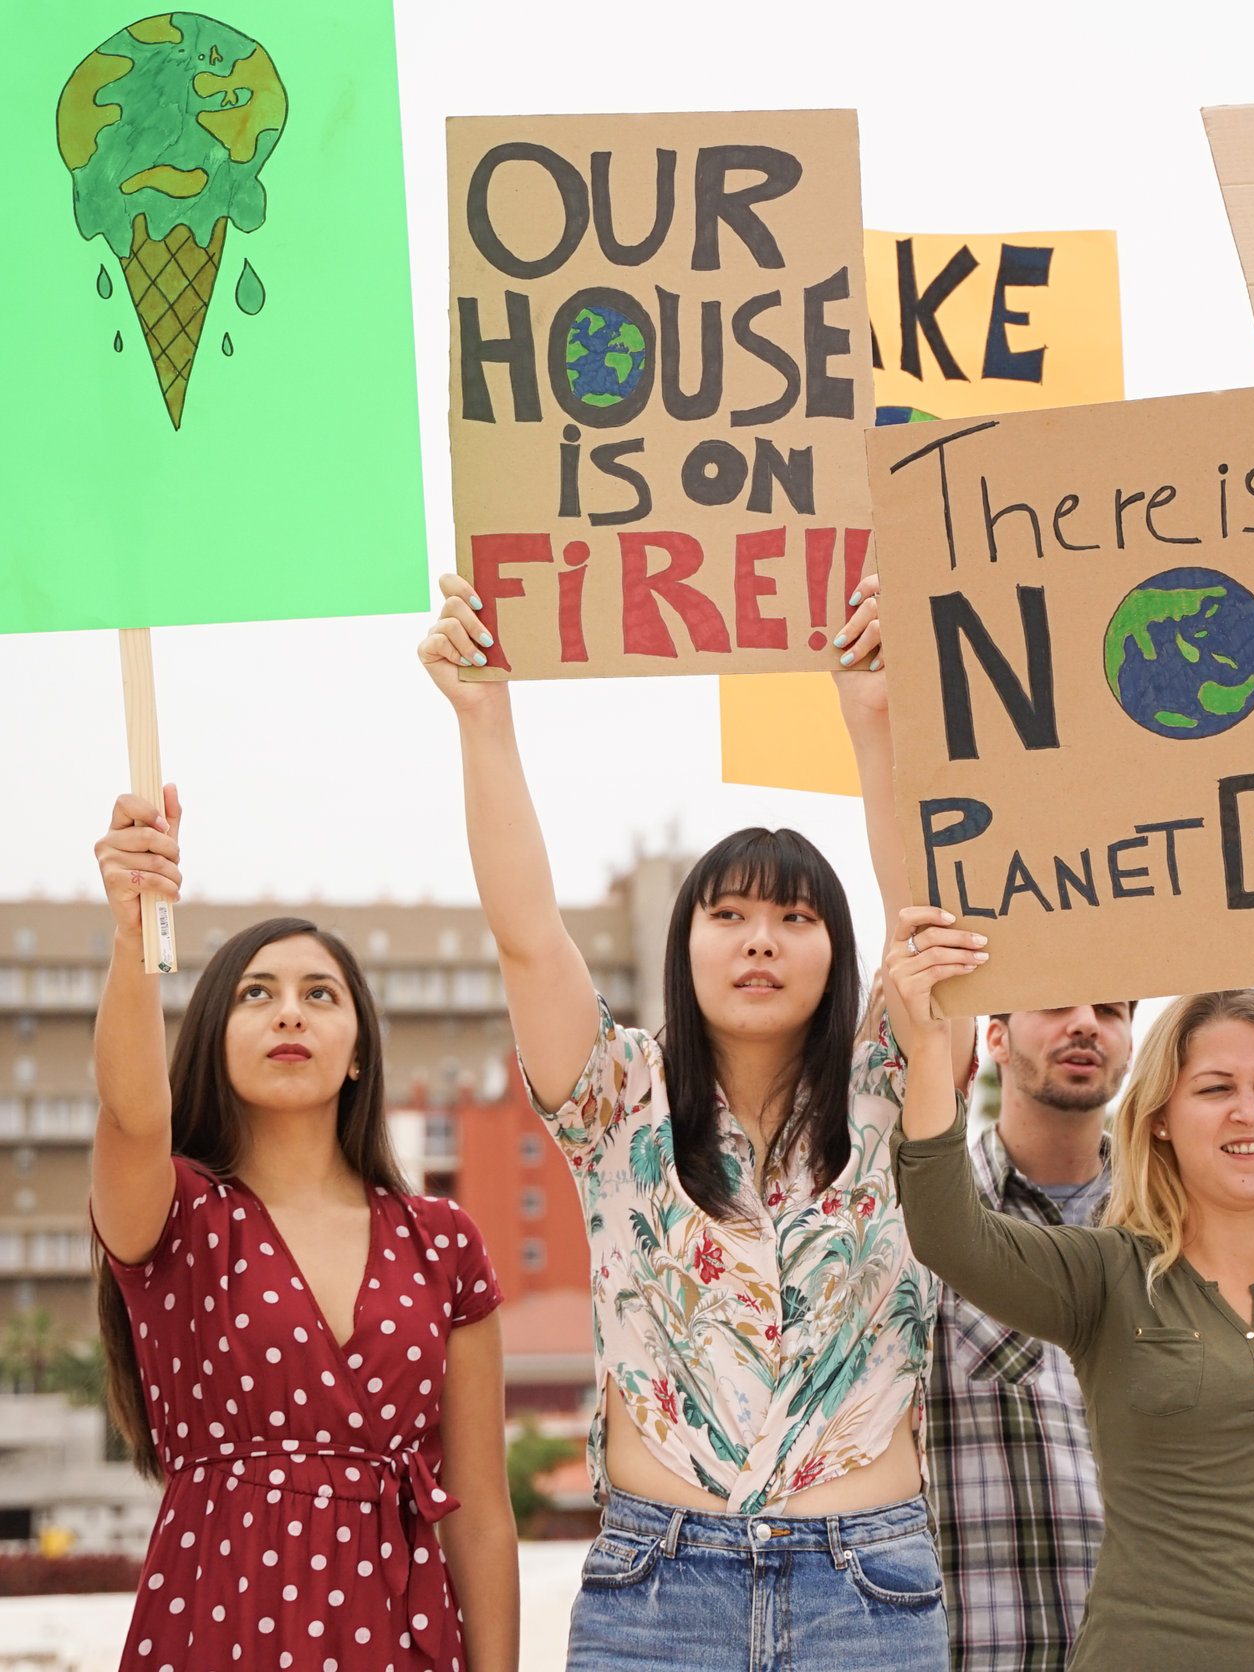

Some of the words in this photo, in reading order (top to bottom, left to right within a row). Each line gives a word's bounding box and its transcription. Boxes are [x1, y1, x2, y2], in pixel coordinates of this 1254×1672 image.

[467, 142, 803, 279] OUR
[457, 266, 855, 428] HOUSE
[870, 237, 1055, 386] KE
[681, 436, 816, 517] ON
[889, 421, 1203, 570] There
[920, 798, 1205, 919] PLANET
